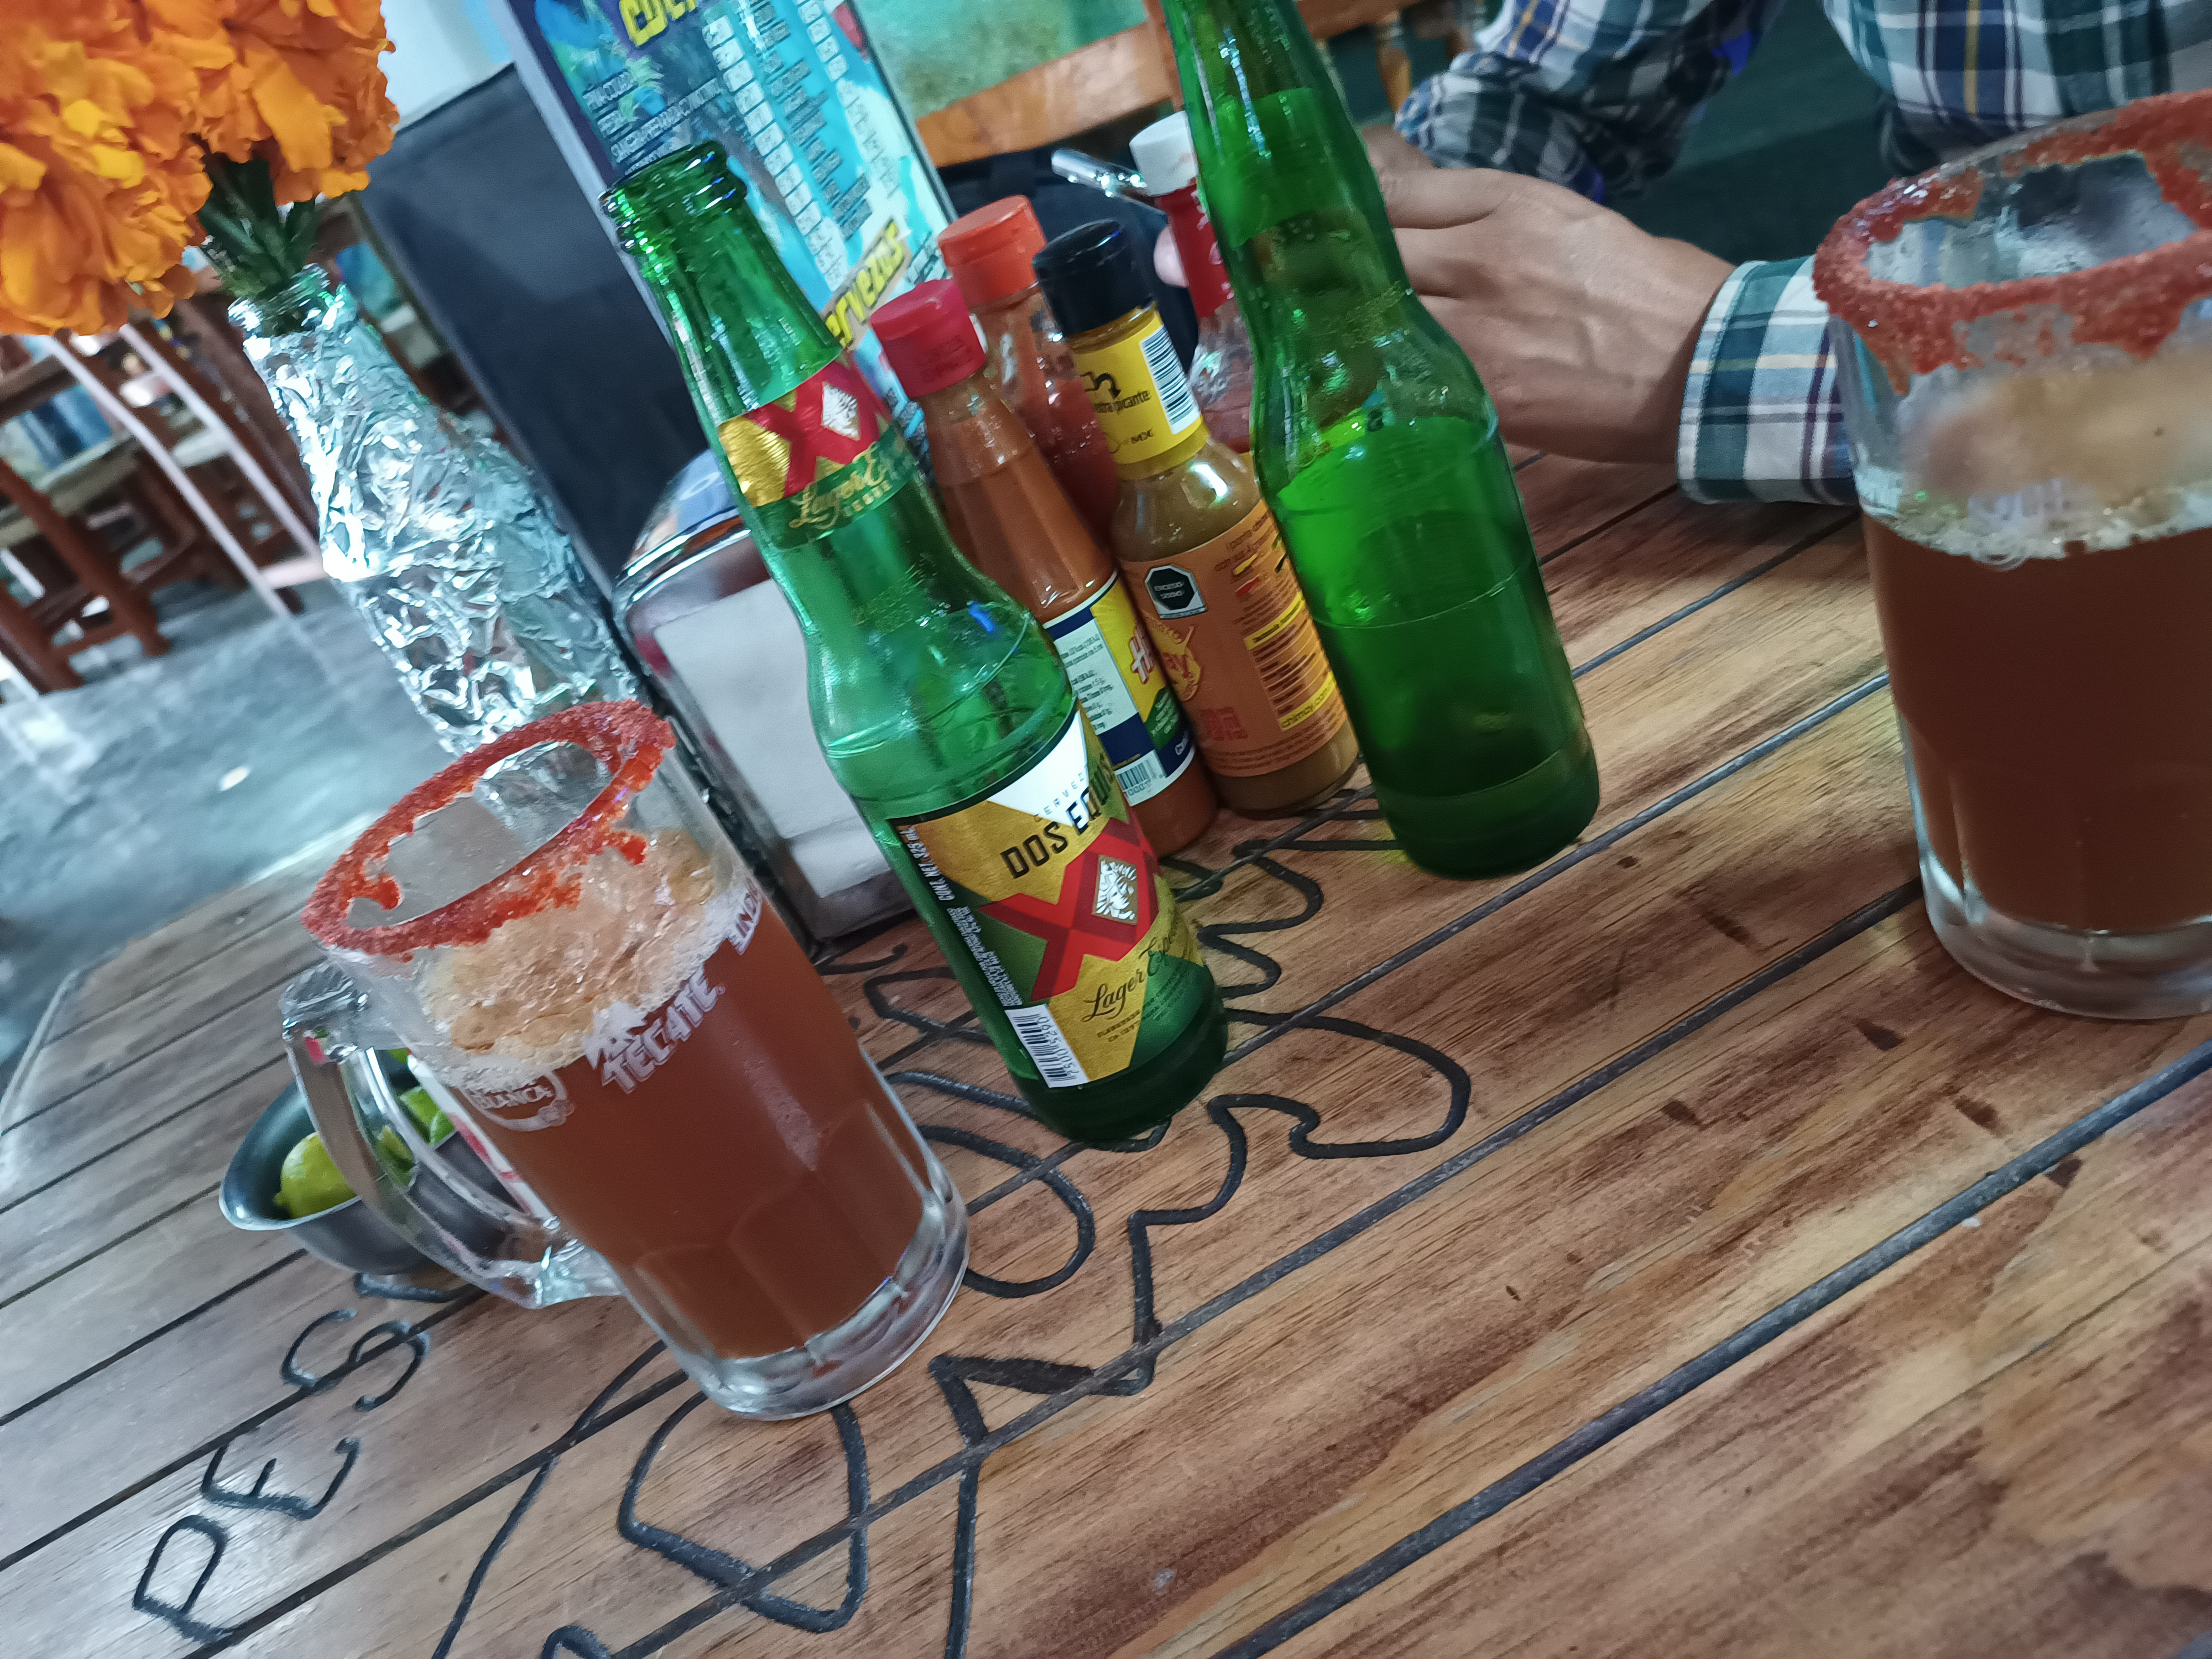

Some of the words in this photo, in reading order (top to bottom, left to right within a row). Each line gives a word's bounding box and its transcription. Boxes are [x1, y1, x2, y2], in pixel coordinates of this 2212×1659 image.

[1000, 822, 1068, 879] DOS
[1081, 971, 1145, 1022] Lager
[602, 966, 718, 1094] TECATE
